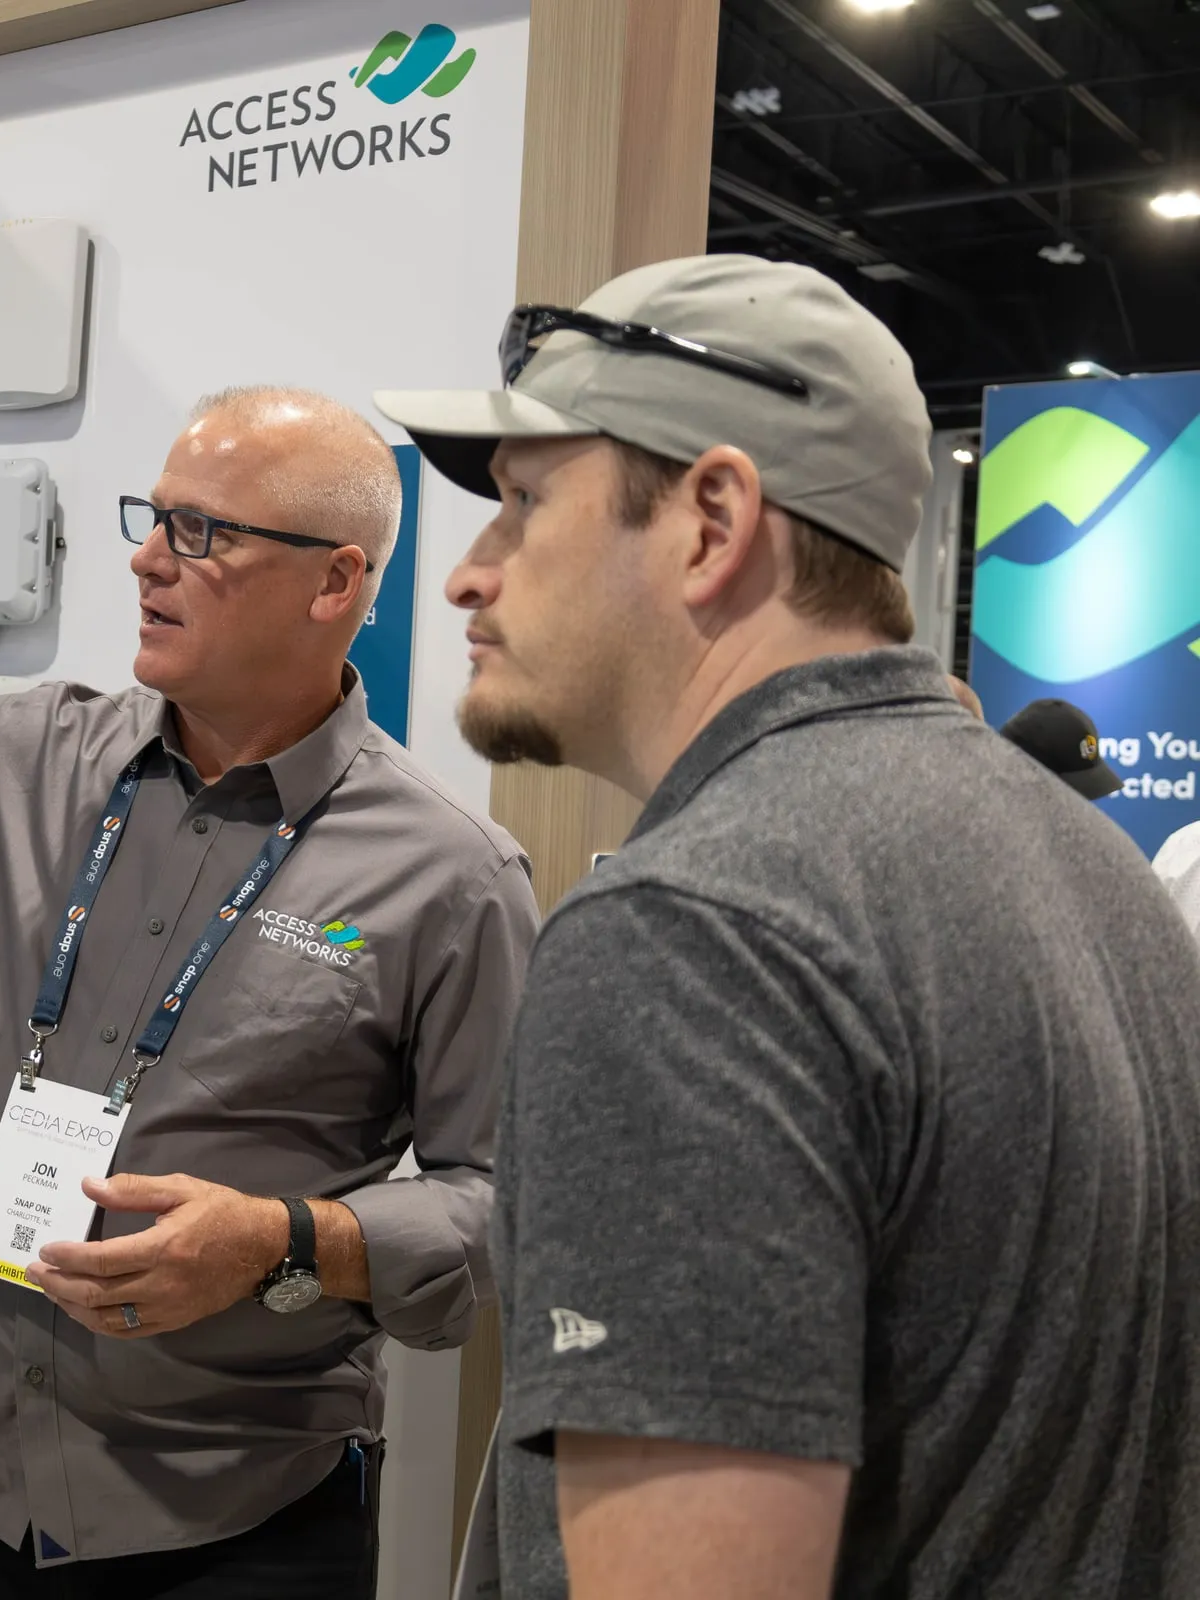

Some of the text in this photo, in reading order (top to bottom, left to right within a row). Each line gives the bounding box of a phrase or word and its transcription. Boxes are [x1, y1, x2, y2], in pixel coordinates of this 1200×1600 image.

[179, 80, 337, 147] ACCESS
[208, 113, 451, 192] NETWORKS
[1108, 771, 1195, 800] cted
[85, 831, 112, 882] snap one
[232, 859, 270, 907] snap one
[253, 908, 317, 936] ACCESS
[53, 922, 77, 977] snap one
[259, 924, 352, 966] NETWORKS
[175, 942, 210, 994] snap one
[9, 1105, 61, 1134] CEDIA
[65, 1120, 113, 1147] EXPO
[23, 1173, 58, 1190] PECKMAN
[32, 1161, 57, 1178] JON
[14, 1197, 52, 1215] SNAP ONE
